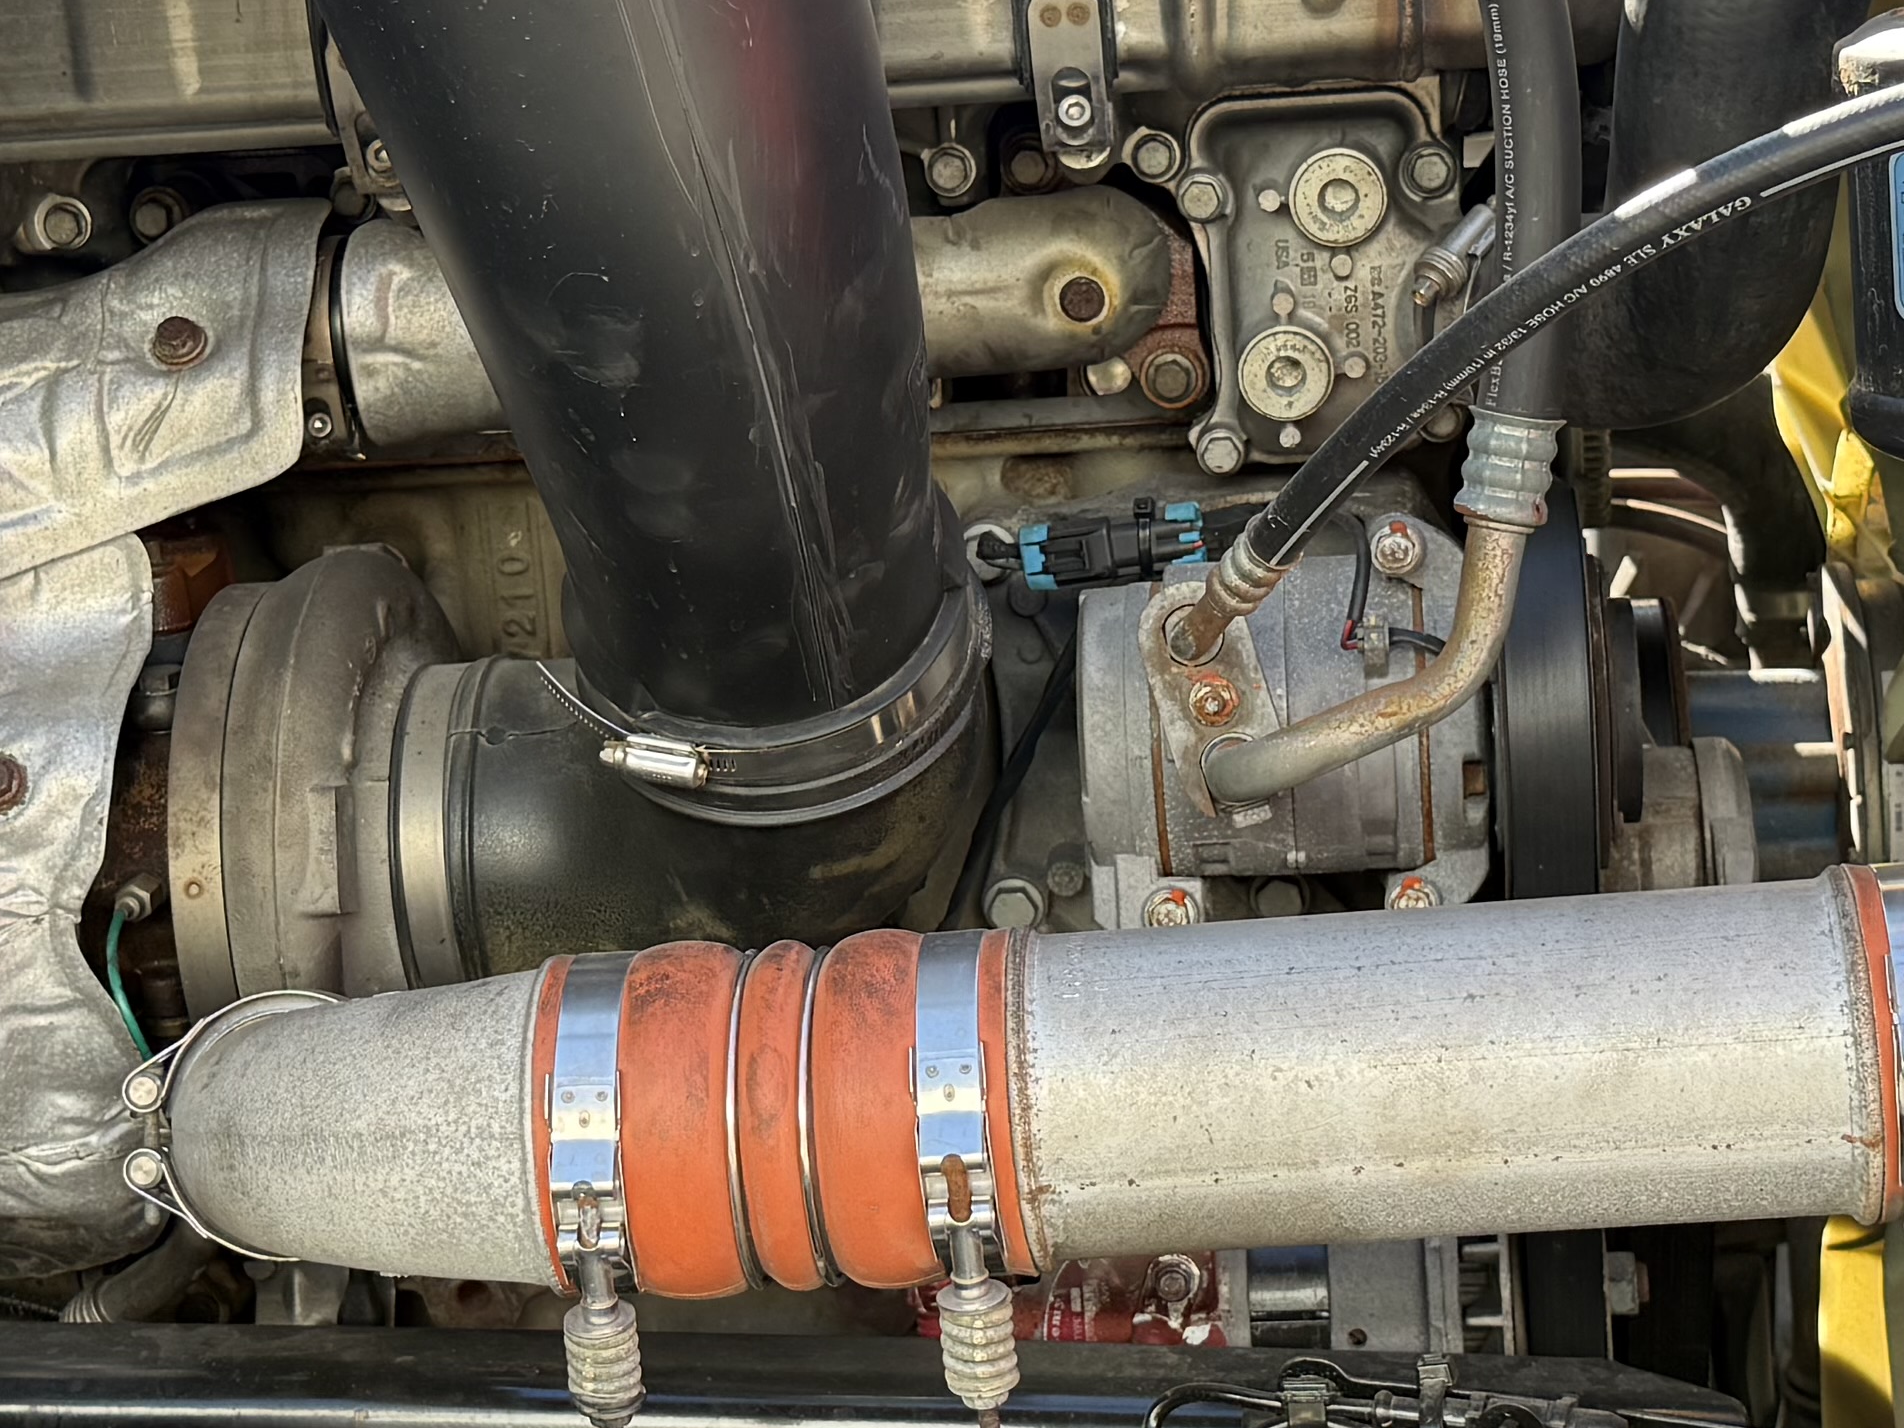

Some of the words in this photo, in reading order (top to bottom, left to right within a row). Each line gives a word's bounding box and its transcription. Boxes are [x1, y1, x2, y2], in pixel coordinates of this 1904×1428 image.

[1487, 3, 1507, 54] (19mm)
[1497, 58, 1511, 100] HOSE
[1500, 104, 1515, 169] SUCTION
[1661, 196, 1753, 250] GALAXY
[1274, 239, 1290, 270] USA
[1623, 243, 1657, 267] SLE
[1525, 300, 1565, 329] HOSE
[1345, 321, 1360, 348] 002
[1444, 357, 1486, 391] (10mm)
